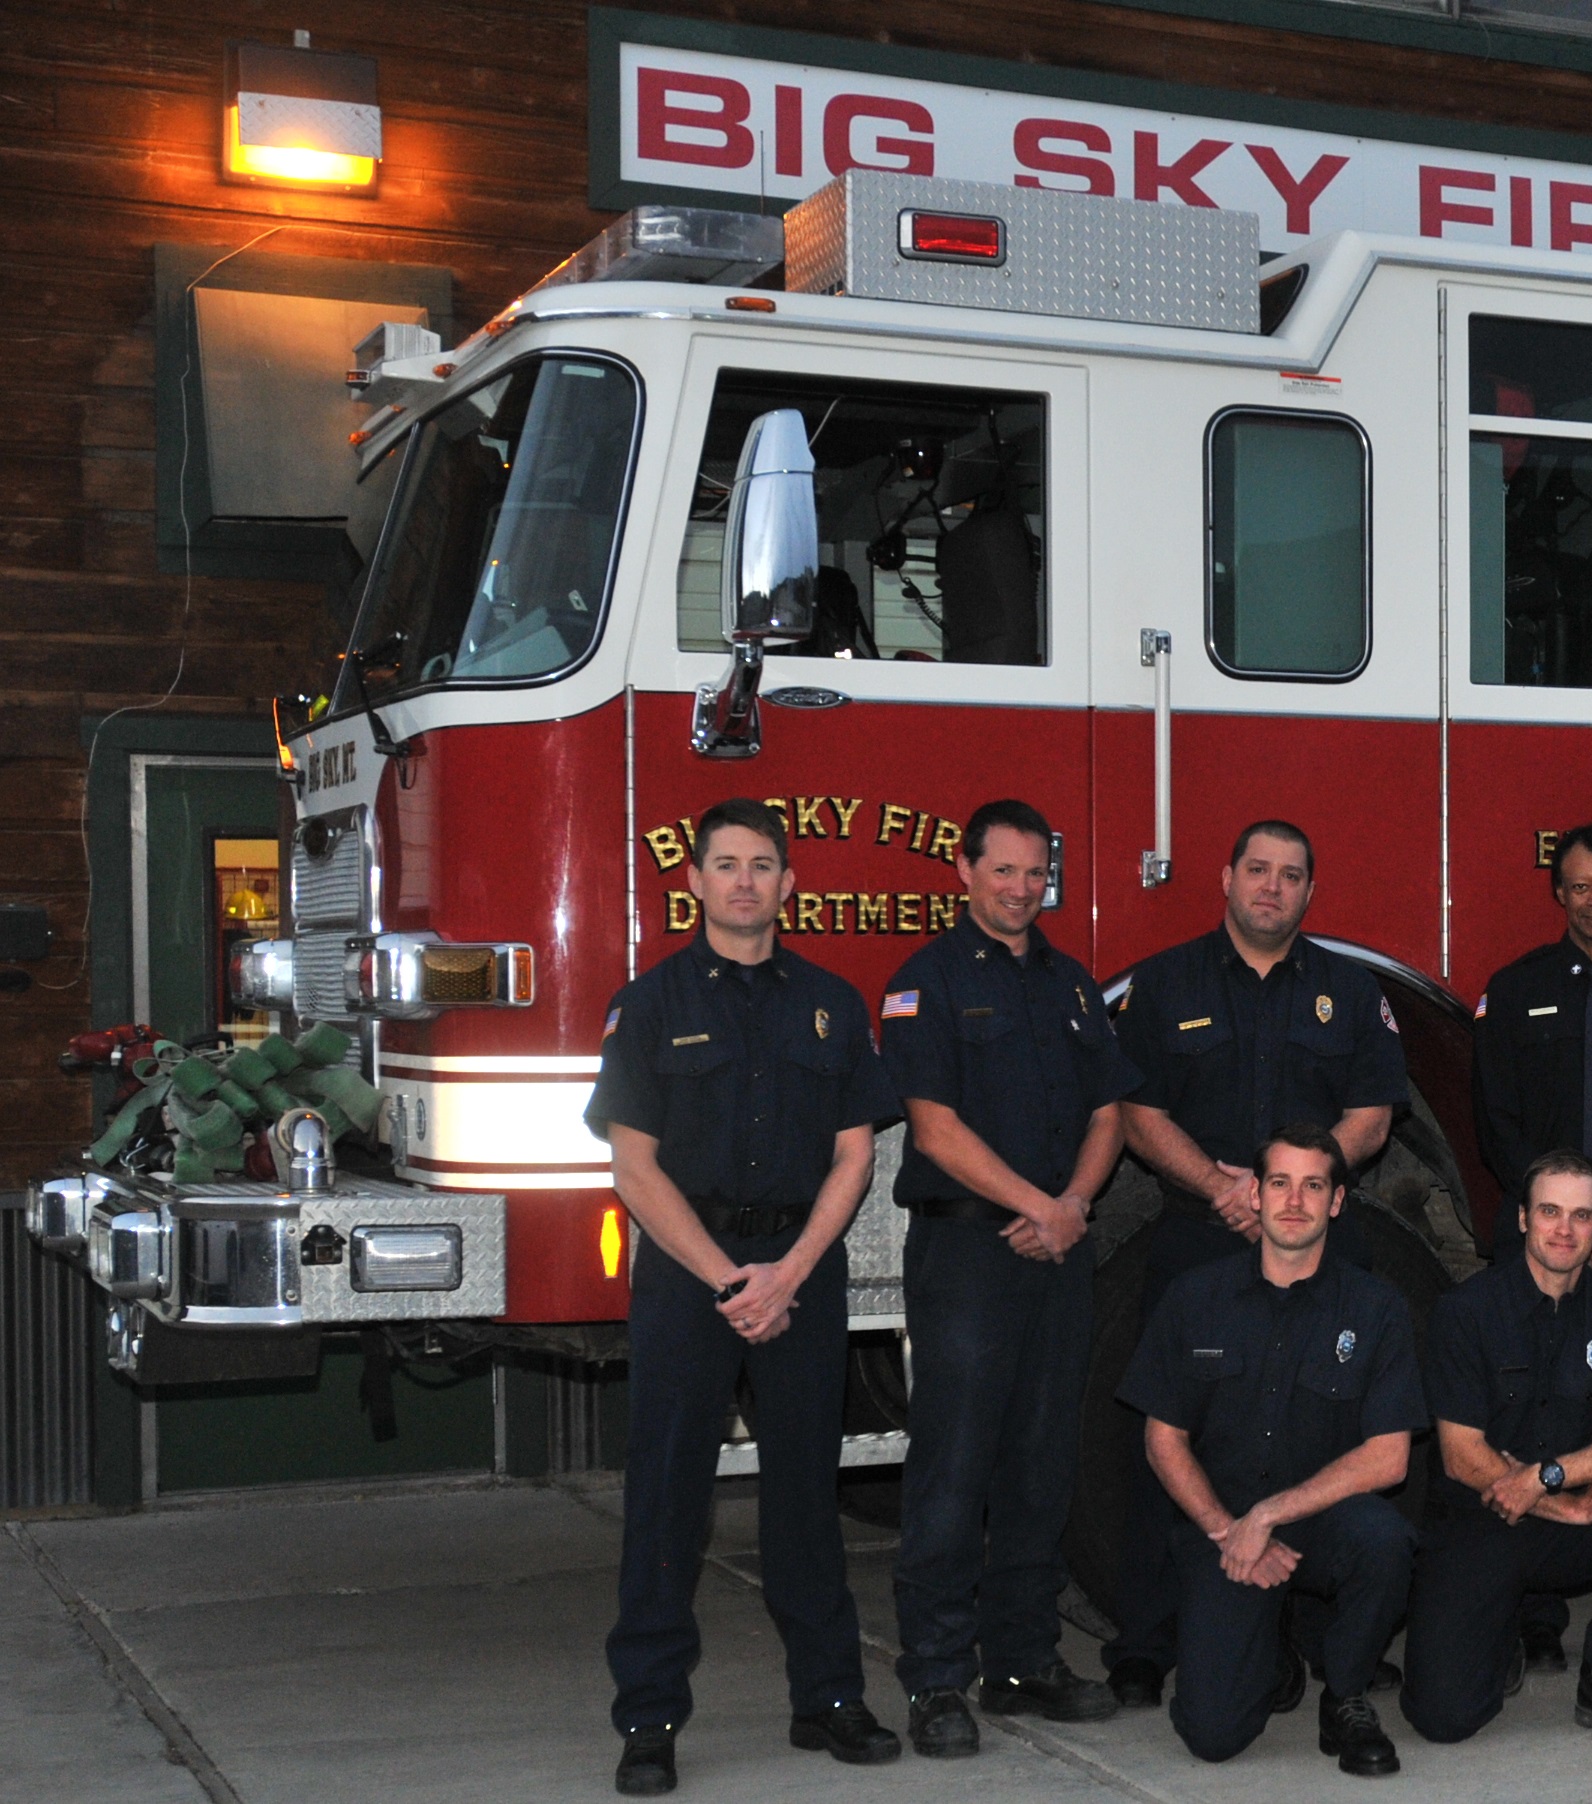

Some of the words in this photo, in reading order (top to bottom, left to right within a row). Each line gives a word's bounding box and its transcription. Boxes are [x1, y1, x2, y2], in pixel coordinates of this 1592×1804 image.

[637, 66, 935, 178] BIG
[1013, 117, 1351, 235] SKY
[641, 815, 698, 874] BI
[874, 802, 960, 868] FIR
[664, 890, 971, 935] DRTMEN
